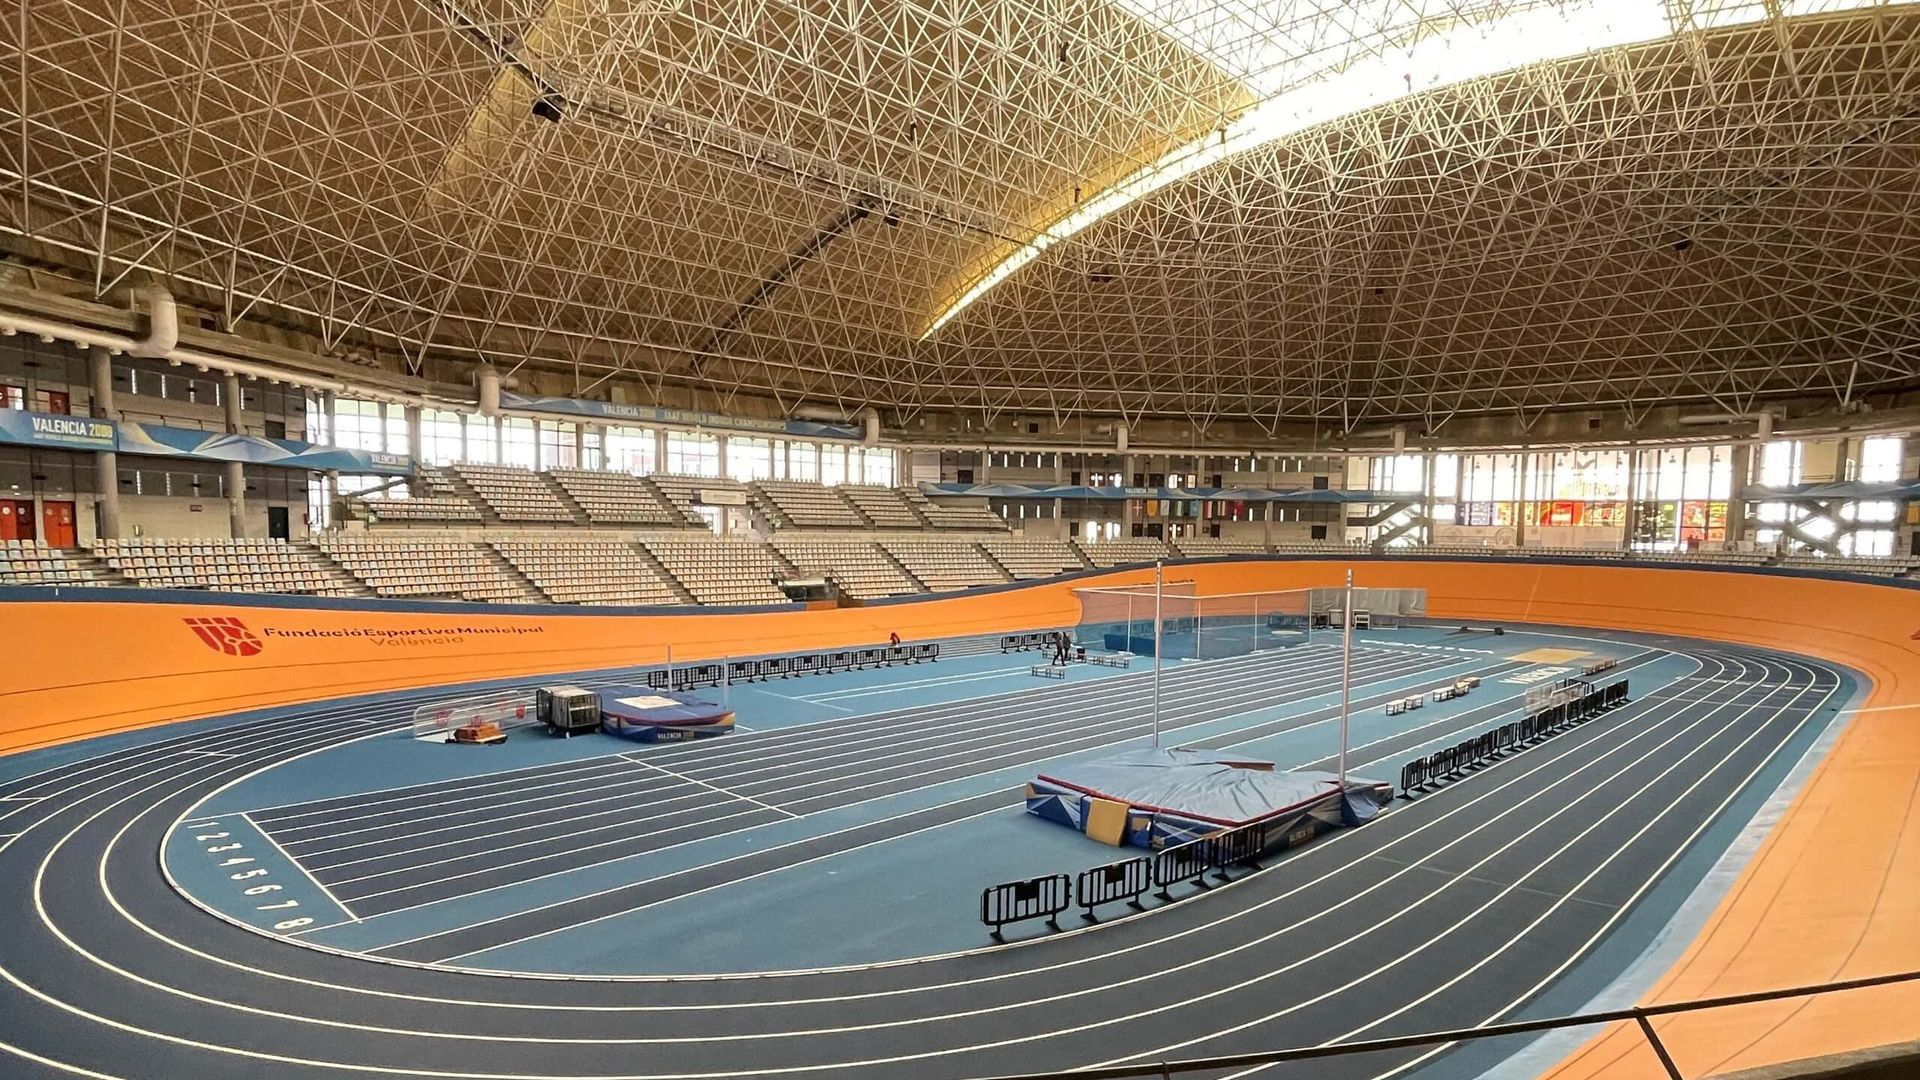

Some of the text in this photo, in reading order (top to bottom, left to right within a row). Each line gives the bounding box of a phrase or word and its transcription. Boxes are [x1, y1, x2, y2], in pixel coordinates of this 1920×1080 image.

[32, 416, 87, 436] VALENCIA
[195, 831, 230, 841] 2
[207, 843, 243, 853] 3
[219, 857, 256, 867] 4
[230, 868, 268, 880] 5
[243, 884, 283, 895] 6
[256, 900, 299, 910] 7
[274, 917, 314, 930] 8
